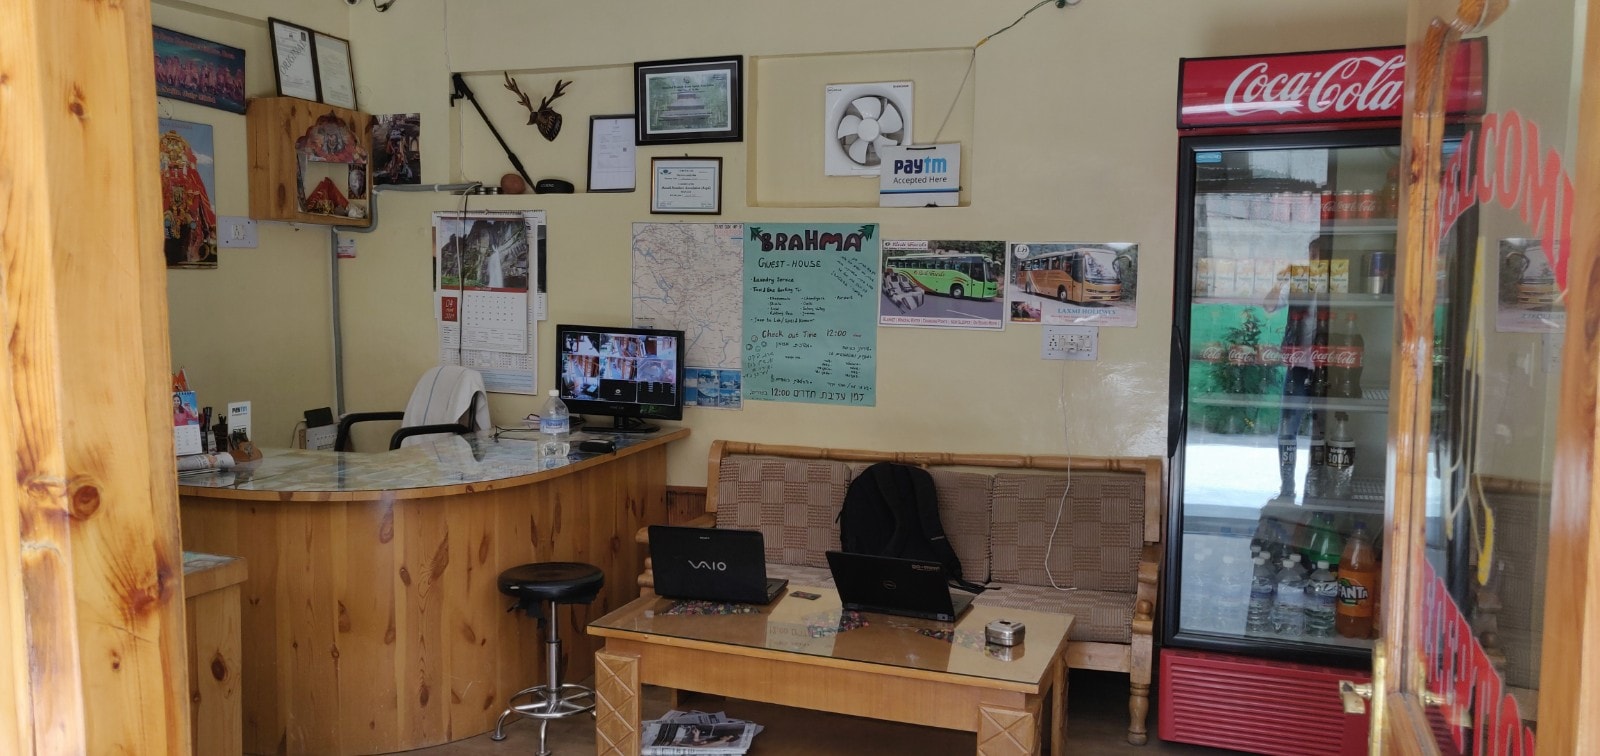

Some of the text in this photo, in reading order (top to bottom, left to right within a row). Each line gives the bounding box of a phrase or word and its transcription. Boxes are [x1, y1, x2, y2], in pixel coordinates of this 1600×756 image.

[1225, 55, 1407, 117] Coca-Cola
[892, 176, 947, 187] Accepted Here
[760, 229, 862, 252] BRAHMA
[761, 329, 784, 339] Check
[803, 330, 817, 338] Time
[826, 329, 847, 337] 12:00
[771, 387, 791, 398] 12:00
[1328, 453, 1350, 464] SODA
[687, 560, 727, 571] VAIO
